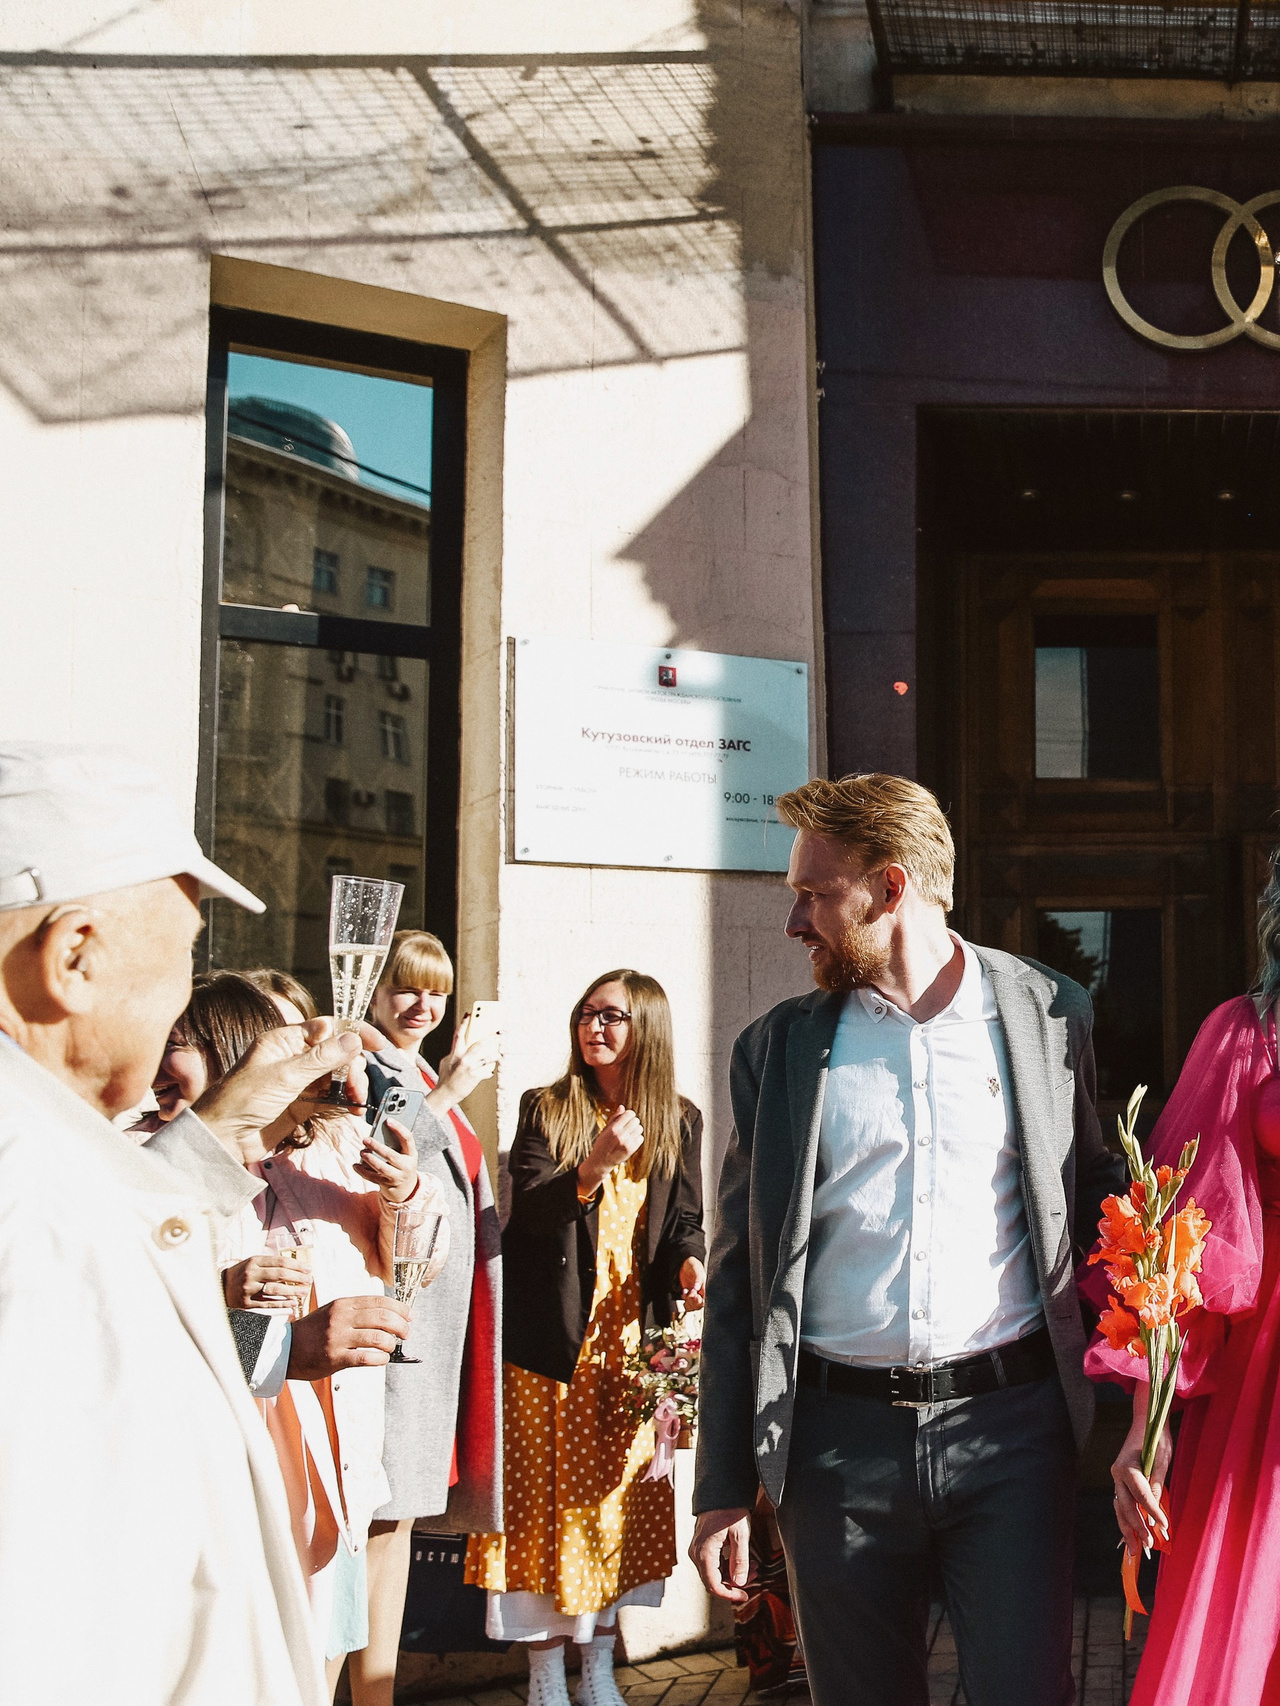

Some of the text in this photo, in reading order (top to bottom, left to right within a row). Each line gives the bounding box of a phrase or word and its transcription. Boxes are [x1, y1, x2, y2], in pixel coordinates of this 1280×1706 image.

[581, 727, 752, 752] Кутузовский отдел ЗАГС
[619, 766, 717, 785] РЕЖИМ РАБОТЫ
[724, 792, 751, 804] 9:00
[762, 794, 775, 806] 18
